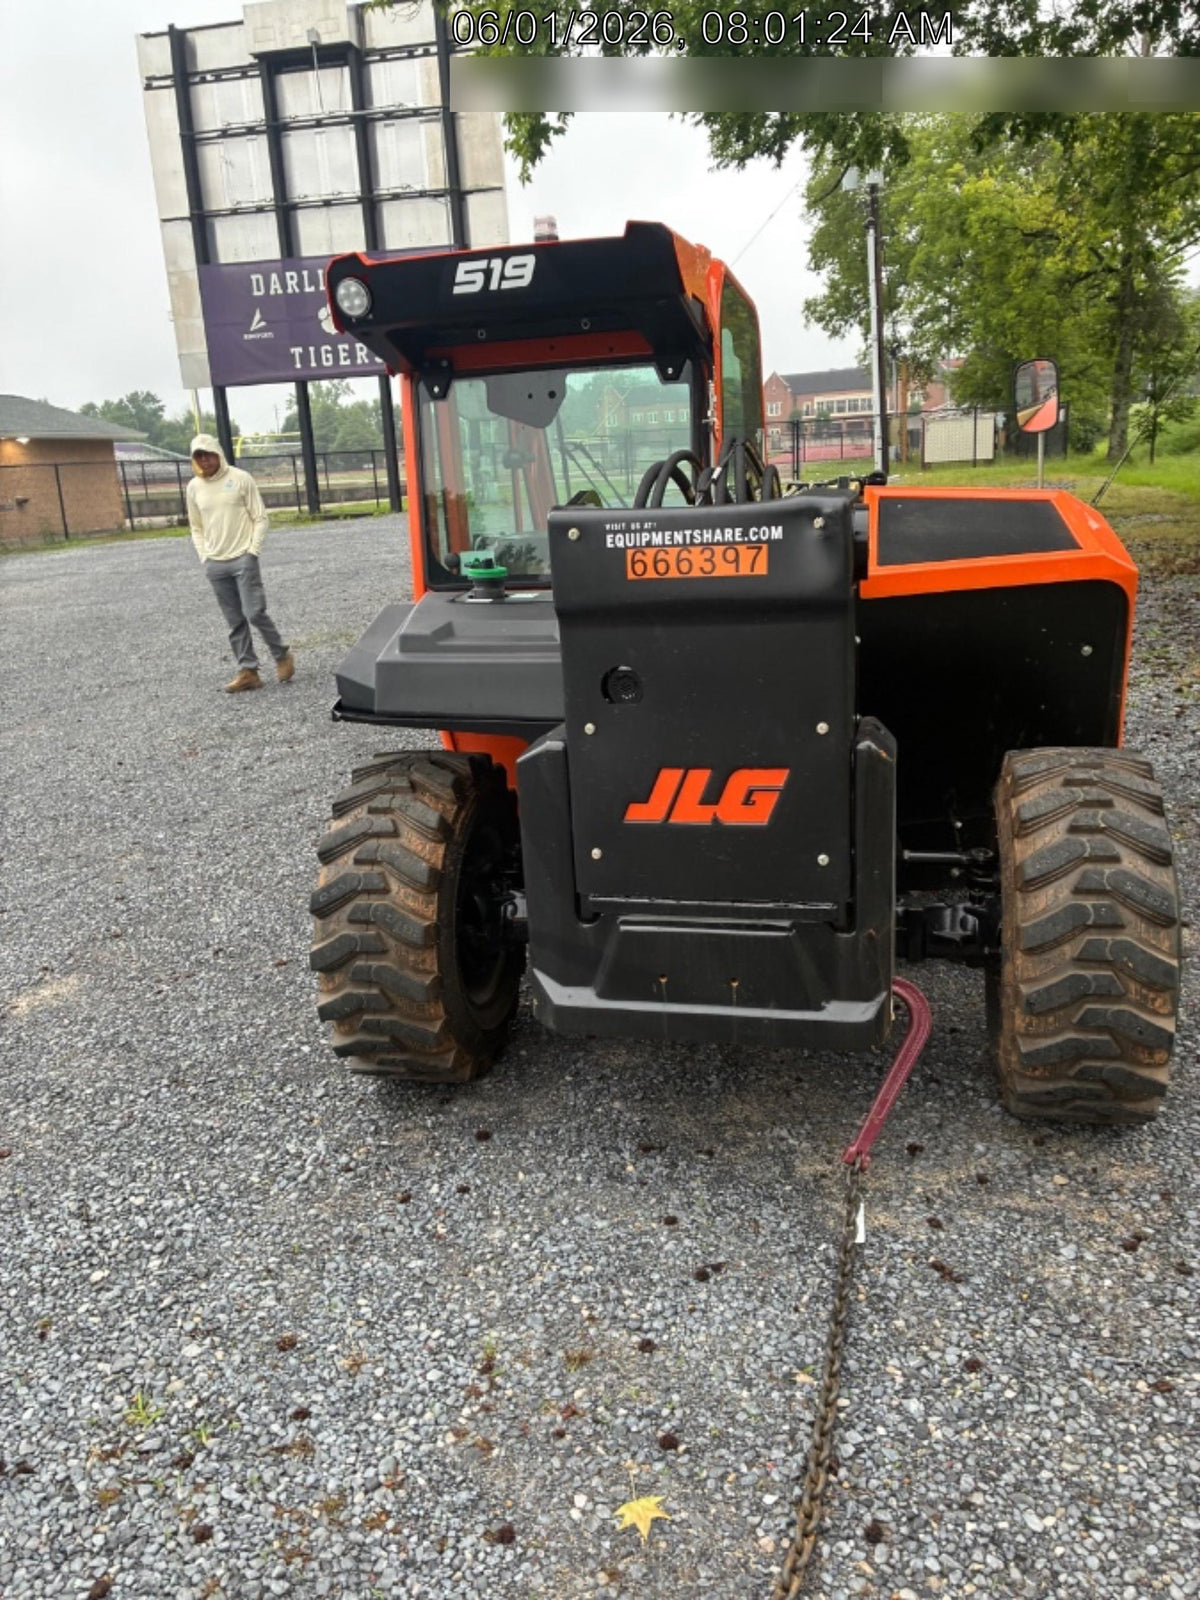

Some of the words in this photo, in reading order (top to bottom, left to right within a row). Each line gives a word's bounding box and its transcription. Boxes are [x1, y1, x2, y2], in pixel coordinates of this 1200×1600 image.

[452, 254, 536, 294] 519
[605, 526, 783, 548] EQUIPMENTSHARE.COM
[630, 545, 763, 577] 666397
[623, 767, 790, 826] JLG
